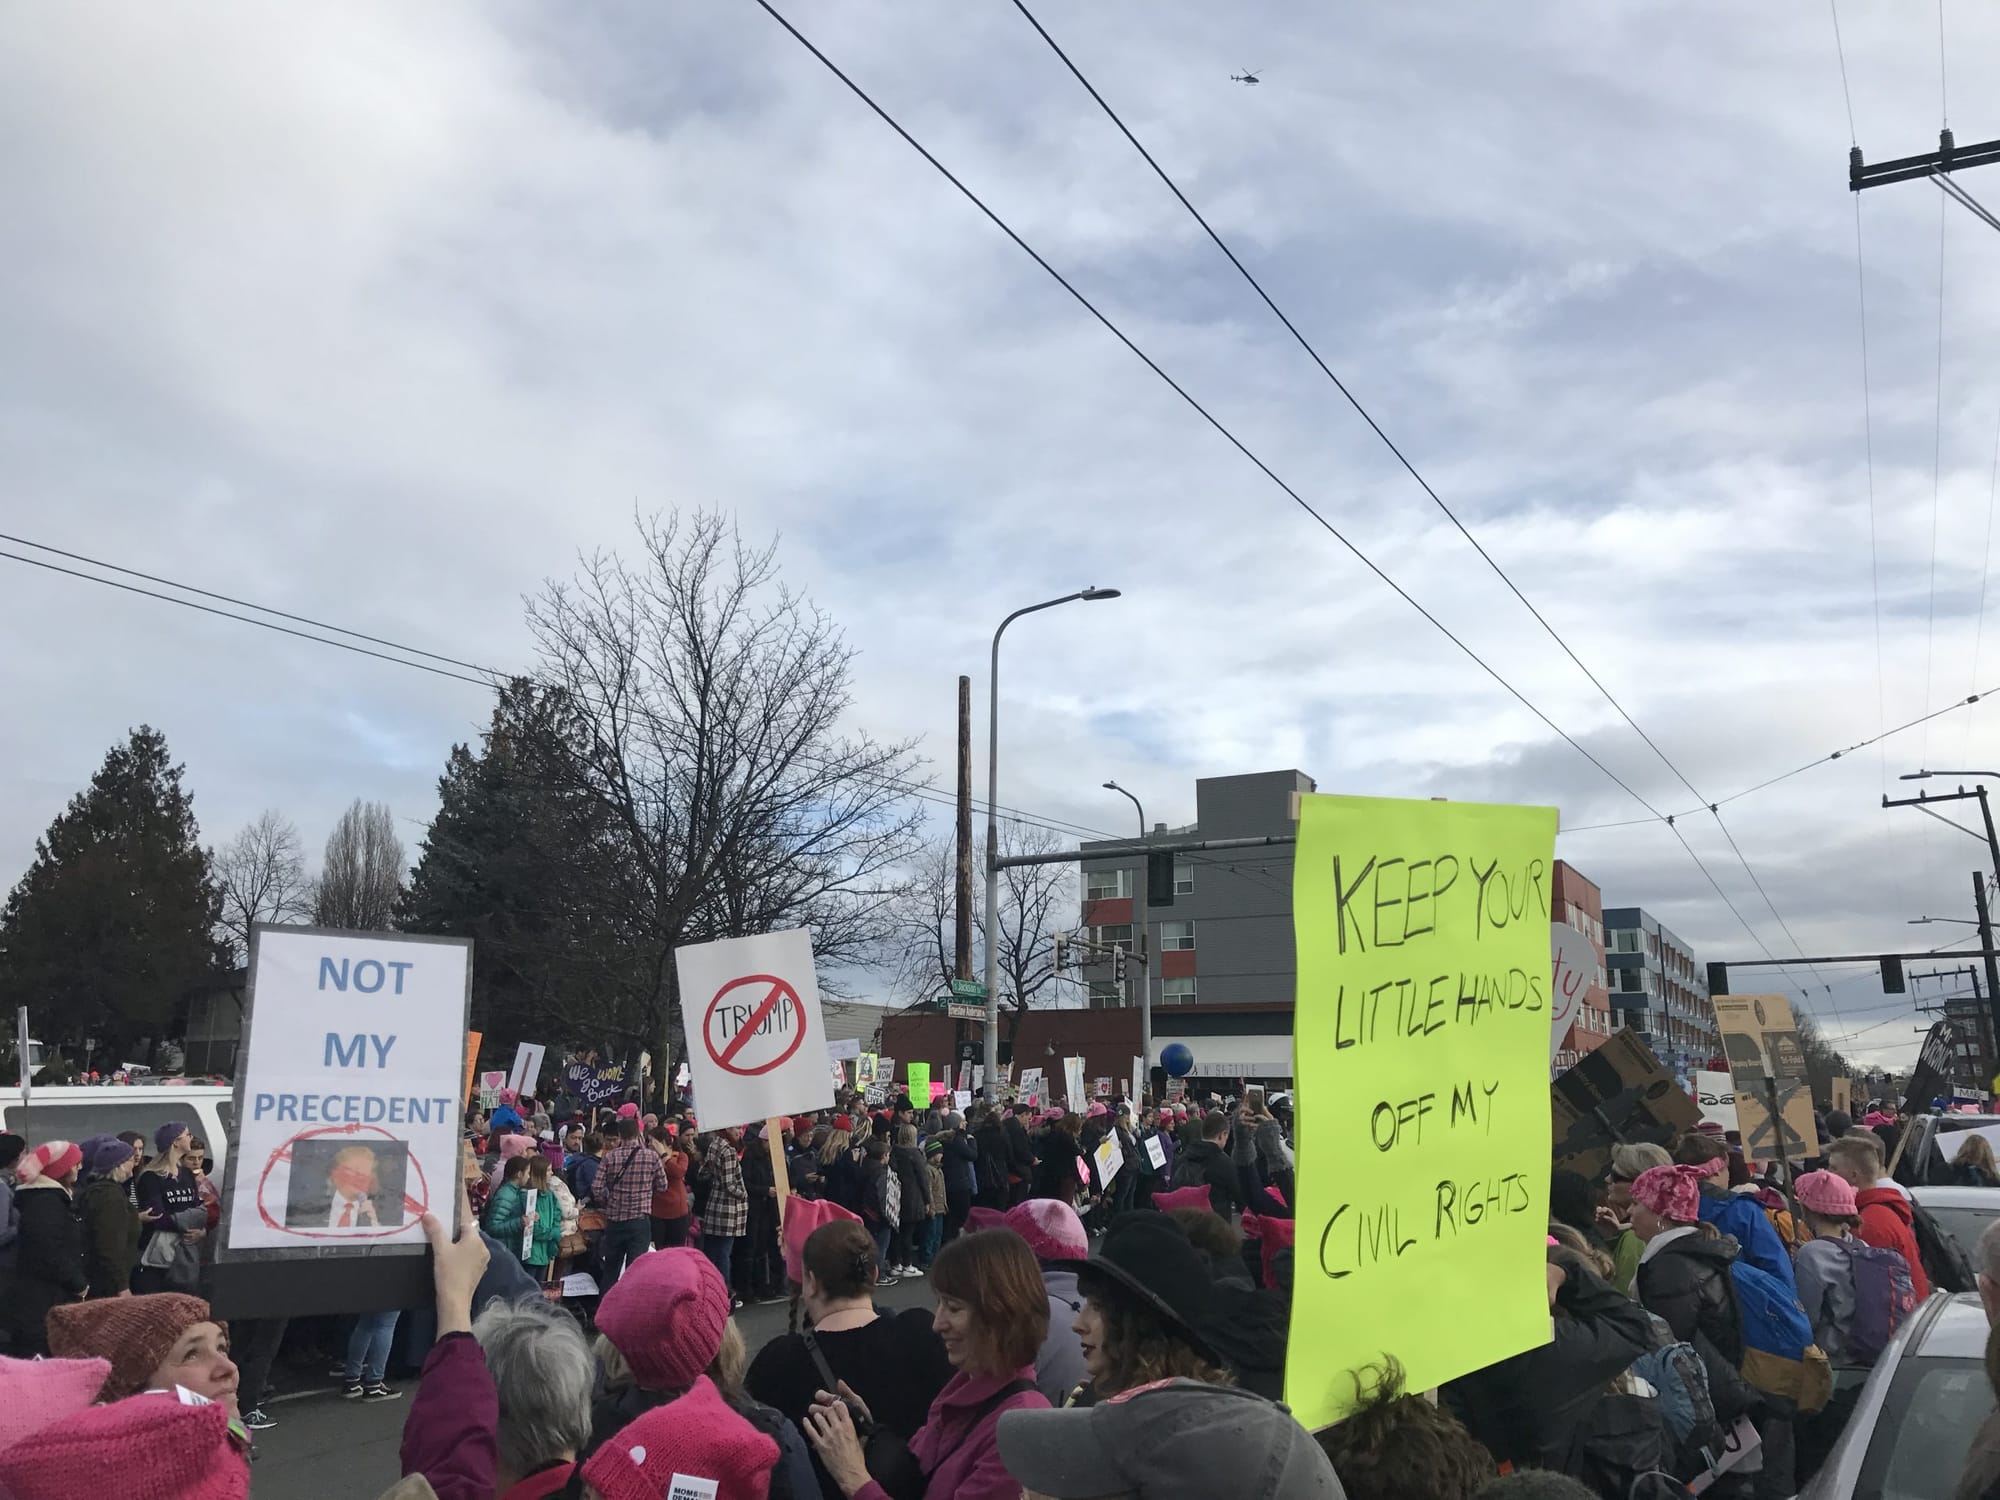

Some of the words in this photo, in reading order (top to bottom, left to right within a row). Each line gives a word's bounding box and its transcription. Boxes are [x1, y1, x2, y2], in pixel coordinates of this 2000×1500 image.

[1333, 855, 1459, 955] KEEP
[1469, 857, 1547, 941] YOUR
[318, 956, 413, 995] NOT
[715, 998, 793, 1038] TRUMP
[1335, 976, 1449, 1049] LITTLE
[1456, 968, 1542, 1026] HANDS
[324, 1032, 397, 1069] MY
[568, 1065, 590, 1080] We
[877, 1069, 892, 1080] NOW
[1215, 1063, 1257, 1077] SEATTLE
[580, 1078, 600, 1093] go
[587, 1084, 622, 1102] Back
[867, 1087, 883, 1097] BLACK
[254, 1093, 452, 1124] PRECEDENT
[481, 1096, 499, 1107] HAT
[1371, 1093, 1436, 1152] OFF
[1450, 1079, 1499, 1136] MY
[1319, 1203, 1417, 1279] CIVIL
[1435, 1173, 1529, 1240] RIGHTS
[674, 1487, 698, 1497] MOMS
